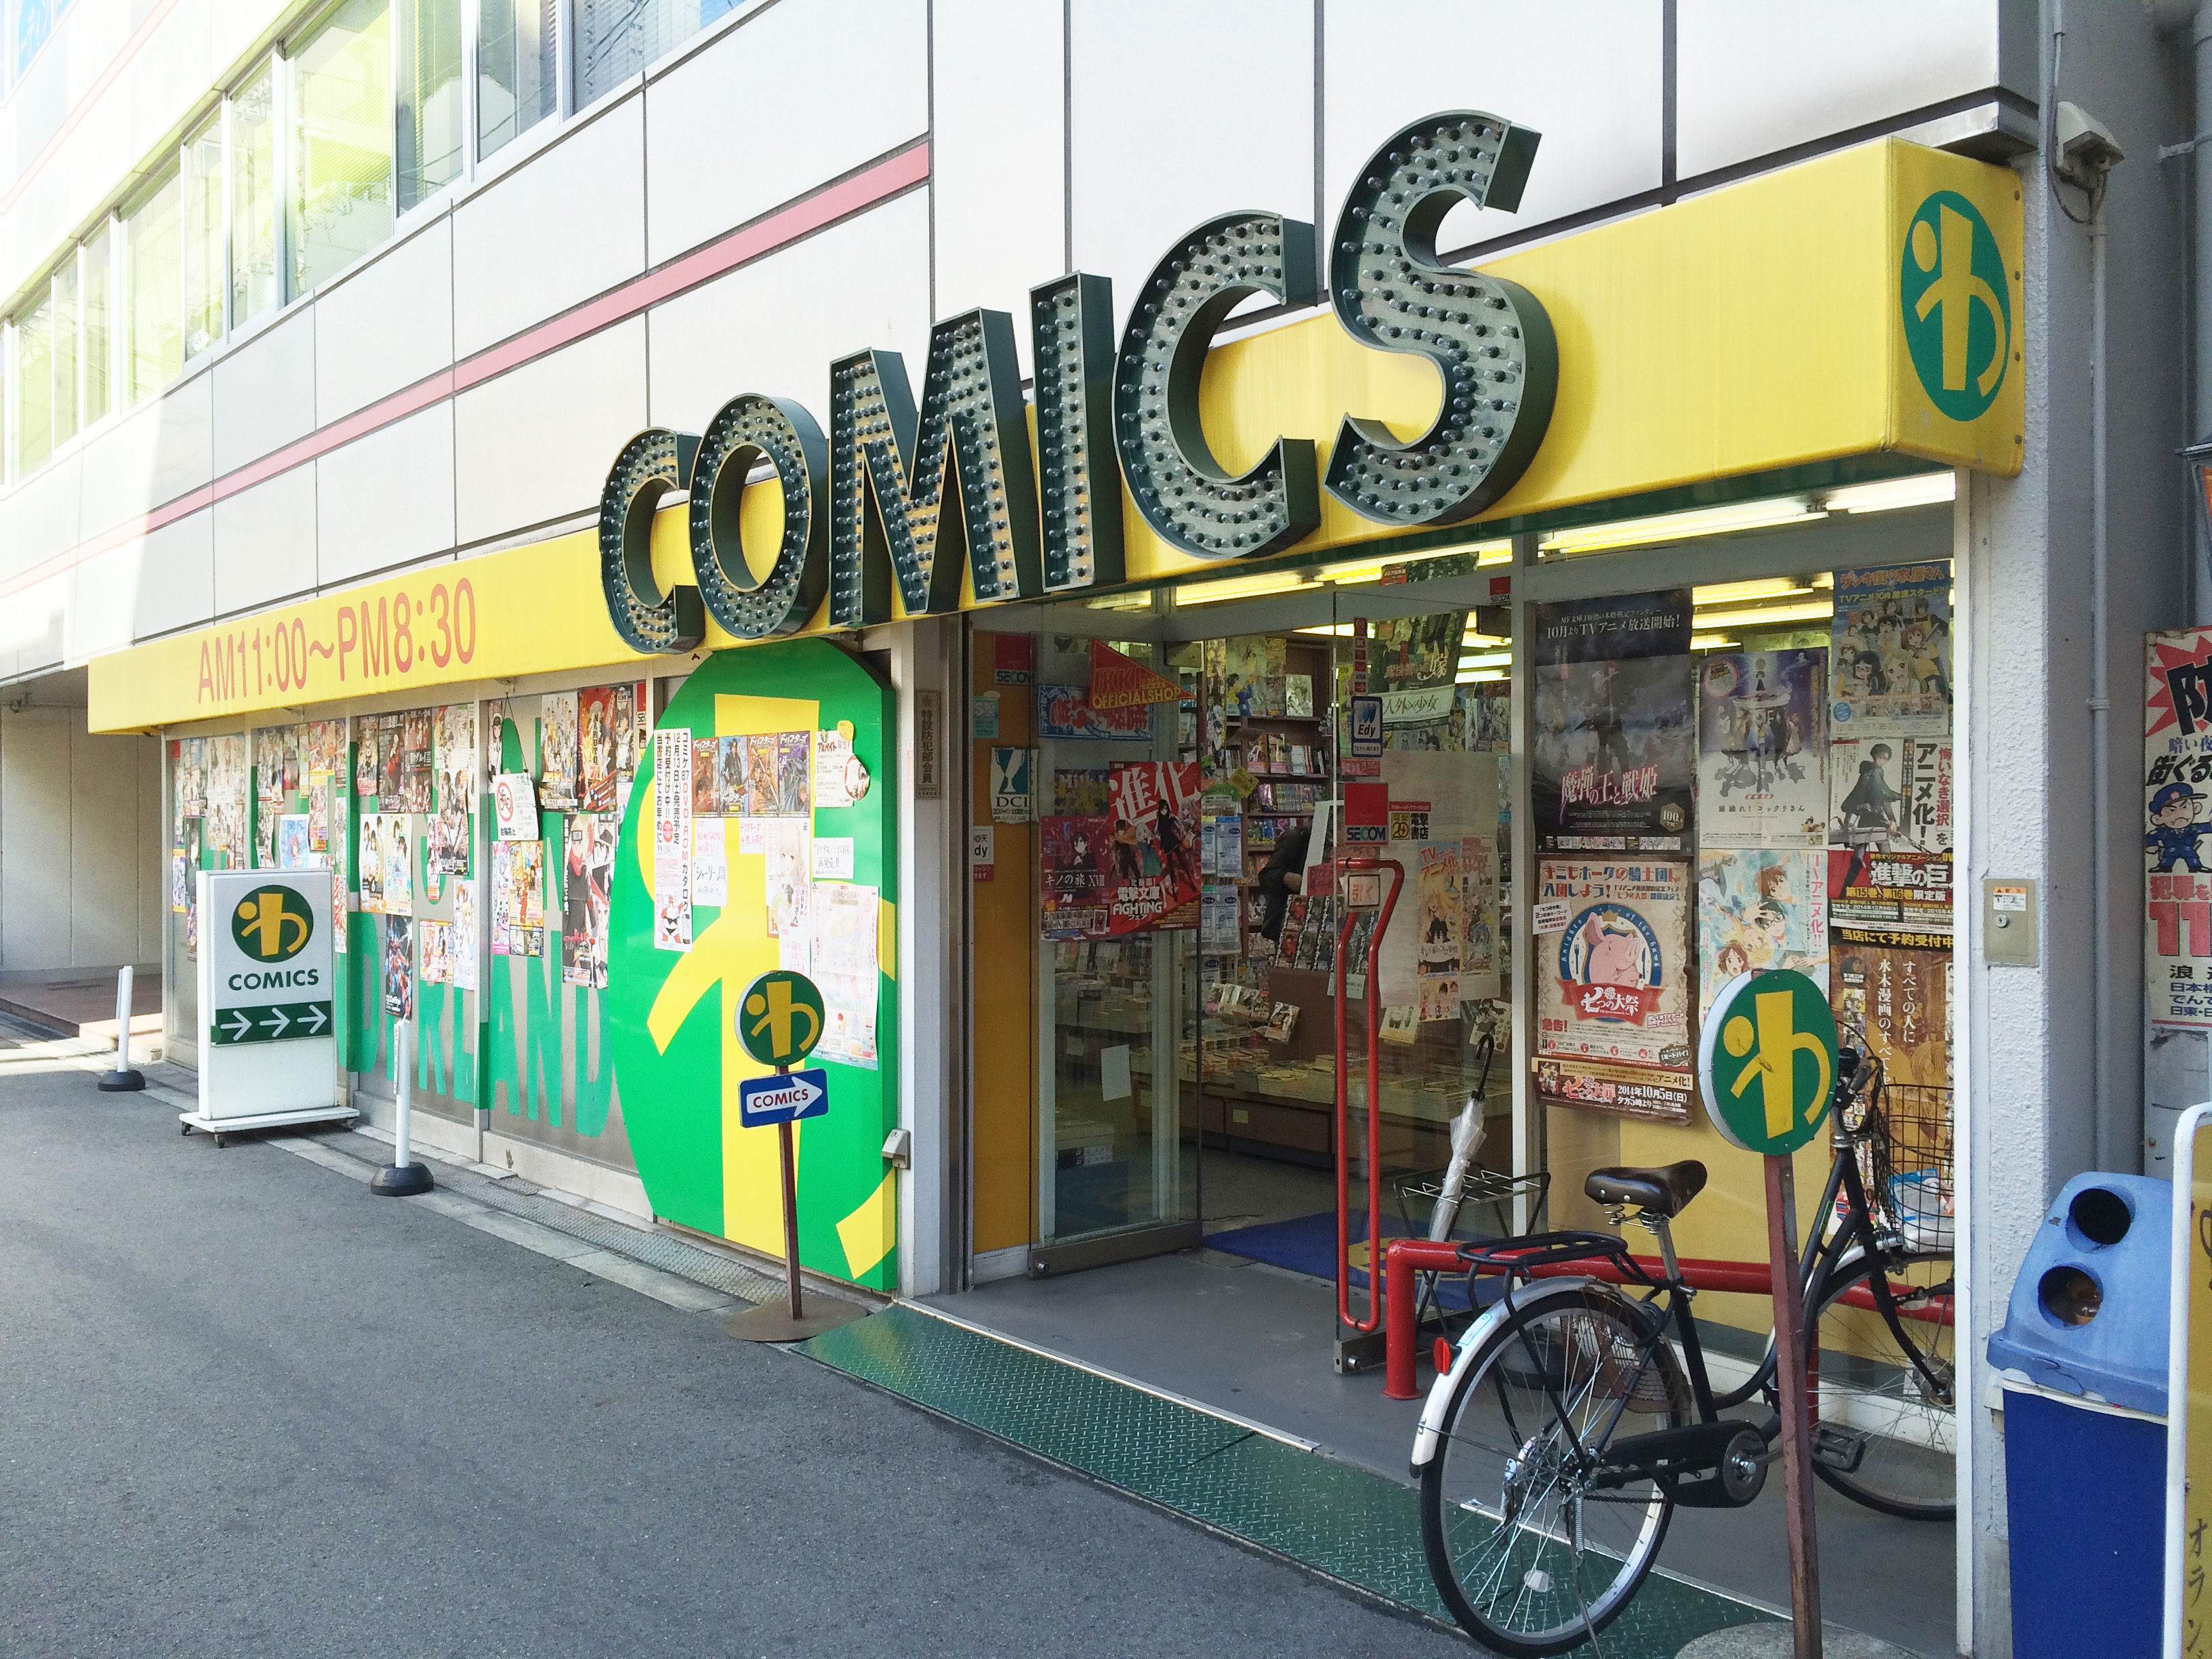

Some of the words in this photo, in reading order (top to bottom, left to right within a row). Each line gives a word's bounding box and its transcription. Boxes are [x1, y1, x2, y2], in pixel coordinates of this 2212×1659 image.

[600, 109, 1559, 654] COMICS
[1358, 724, 1376, 737] Edy
[921, 710, 933, 783] 特設防犯部会員
[996, 796, 1028, 807] DCI
[1912, 743, 1938, 846] アニメ化!
[1347, 827, 1385, 841] SECOM
[1420, 846, 1437, 864] TV
[1045, 873, 1086, 887] キノの旅
[1544, 865, 1681, 882] キミもホークの騎士団に
[1870, 860, 1953, 888] 進撃の巨
[1352, 884, 1373, 902] 引く
[1543, 882, 1612, 899] 入団しよう!
[1113, 901, 1163, 916] FIGHTING
[1842, 929, 1953, 949] 当店にて予約受付中
[228, 968, 319, 991] COMICS
[1903, 961, 1917, 1042] すべての人に
[753, 1088, 809, 1109] COMICS
[1617, 1084, 1687, 1103] 2014年10月5日(日)
